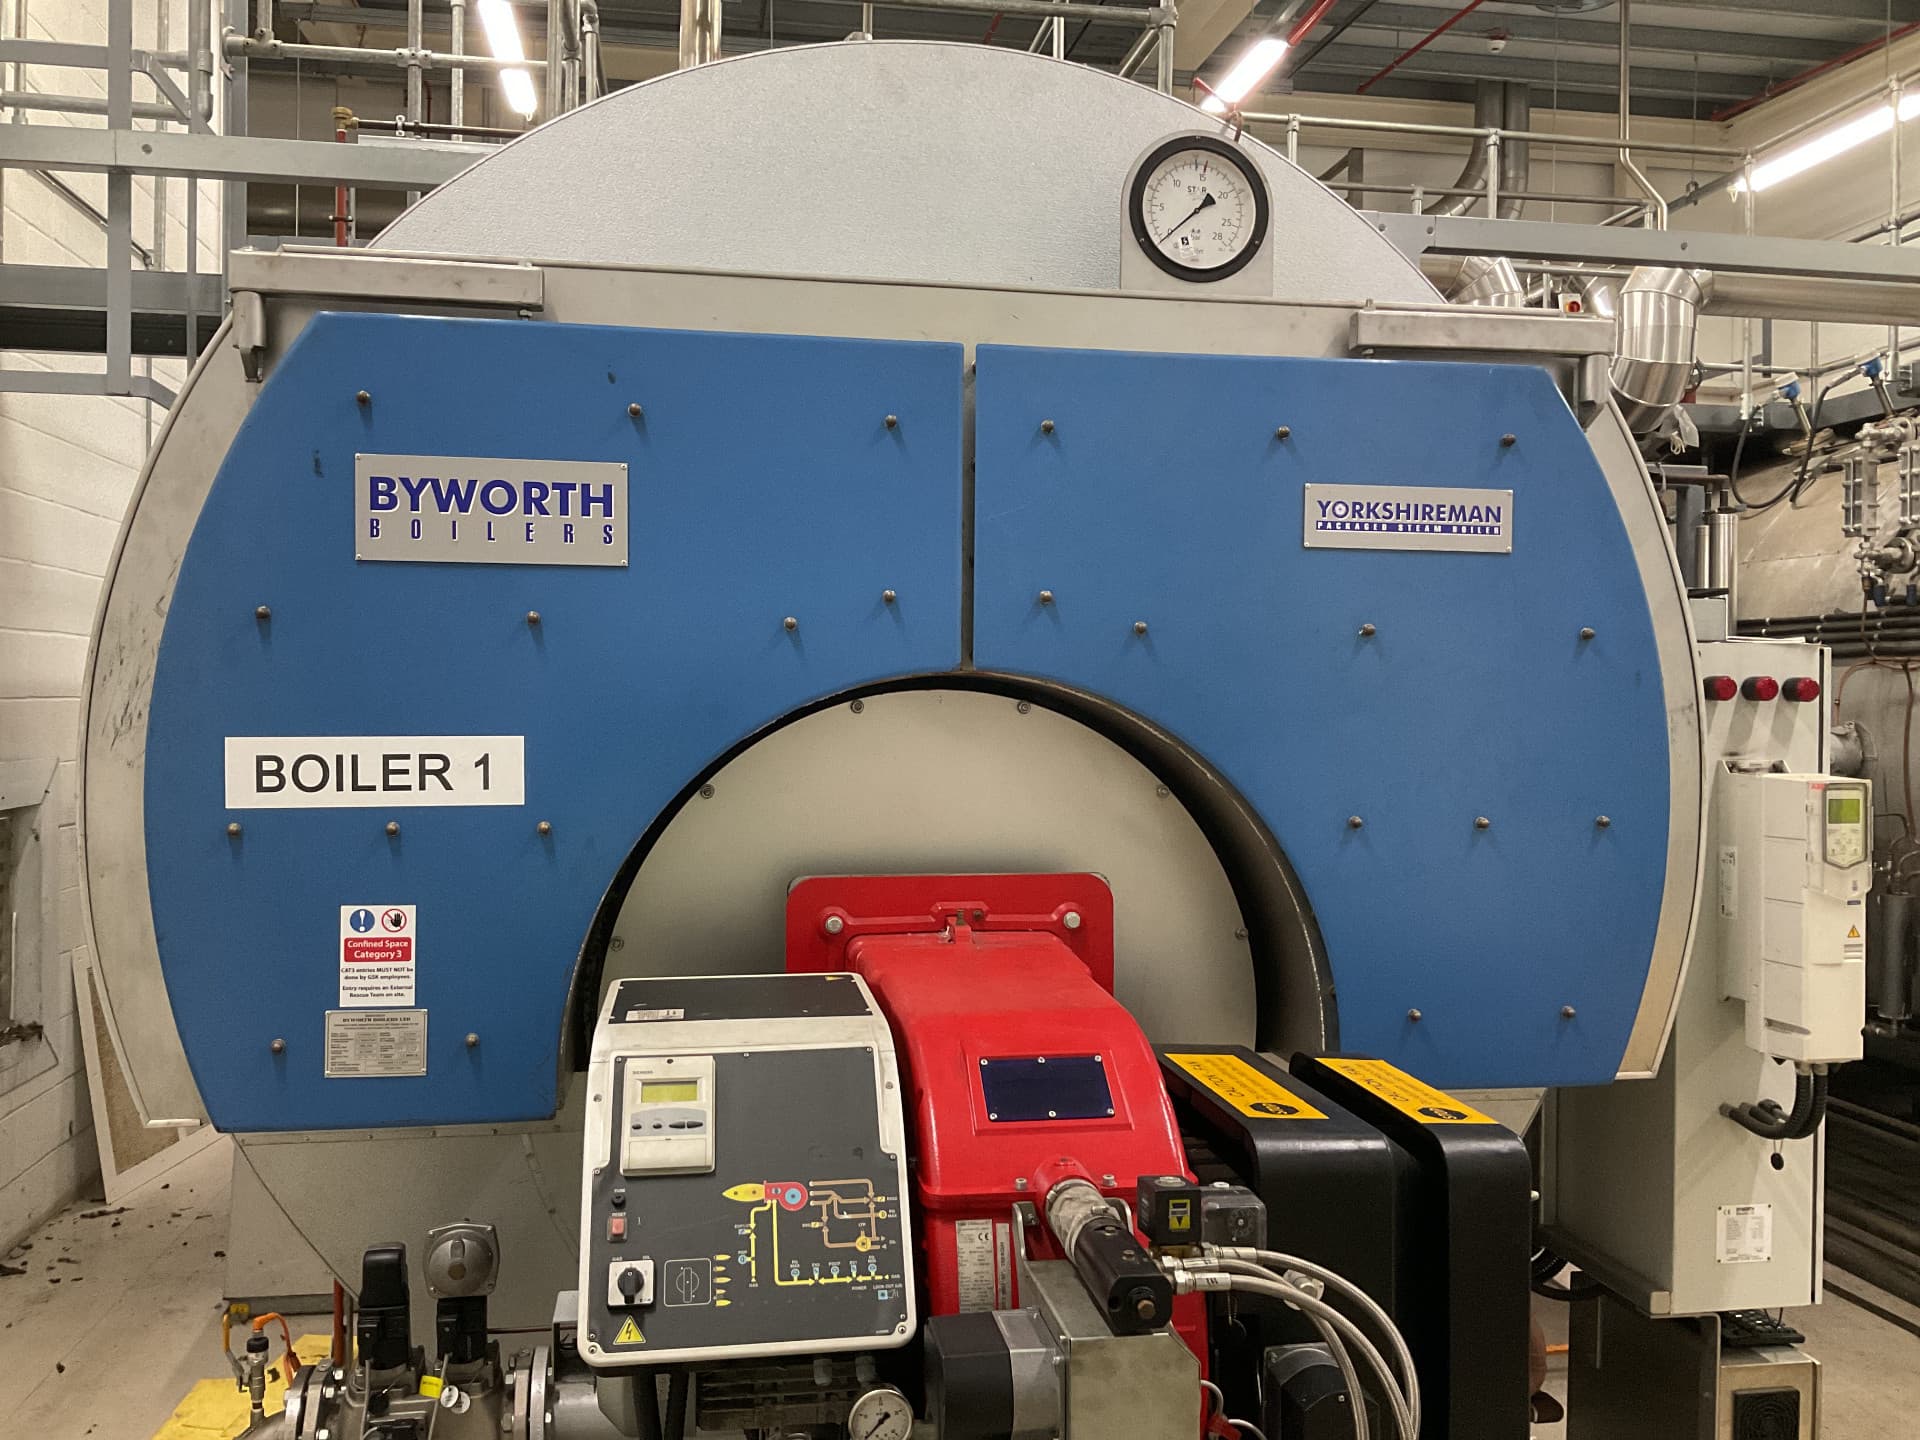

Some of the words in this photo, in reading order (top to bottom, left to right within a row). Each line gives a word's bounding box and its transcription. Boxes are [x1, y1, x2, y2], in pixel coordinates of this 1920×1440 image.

[1173, 179, 1181, 188] 10
[1217, 191, 1229, 200] 20
[1159, 203, 1165, 211] 5
[1221, 218, 1232, 227] 25
[1212, 231, 1223, 241] 28
[369, 476, 614, 518] BYWORTH
[1316, 500, 1501, 523] YORKSHIREMAN
[369, 518, 614, 545] BOILERS
[1317, 521, 1388, 531] PACKAGED
[1397, 523, 1442, 533] STEAM
[1452, 525, 1499, 535] BOILER
[255, 753, 454, 793] BOILER
[474, 752, 490, 791] 1
[347, 940, 384, 948] Confined
[385, 940, 409, 949] Space
[354, 951, 395, 960] Category
[396, 950, 402, 958] 3
